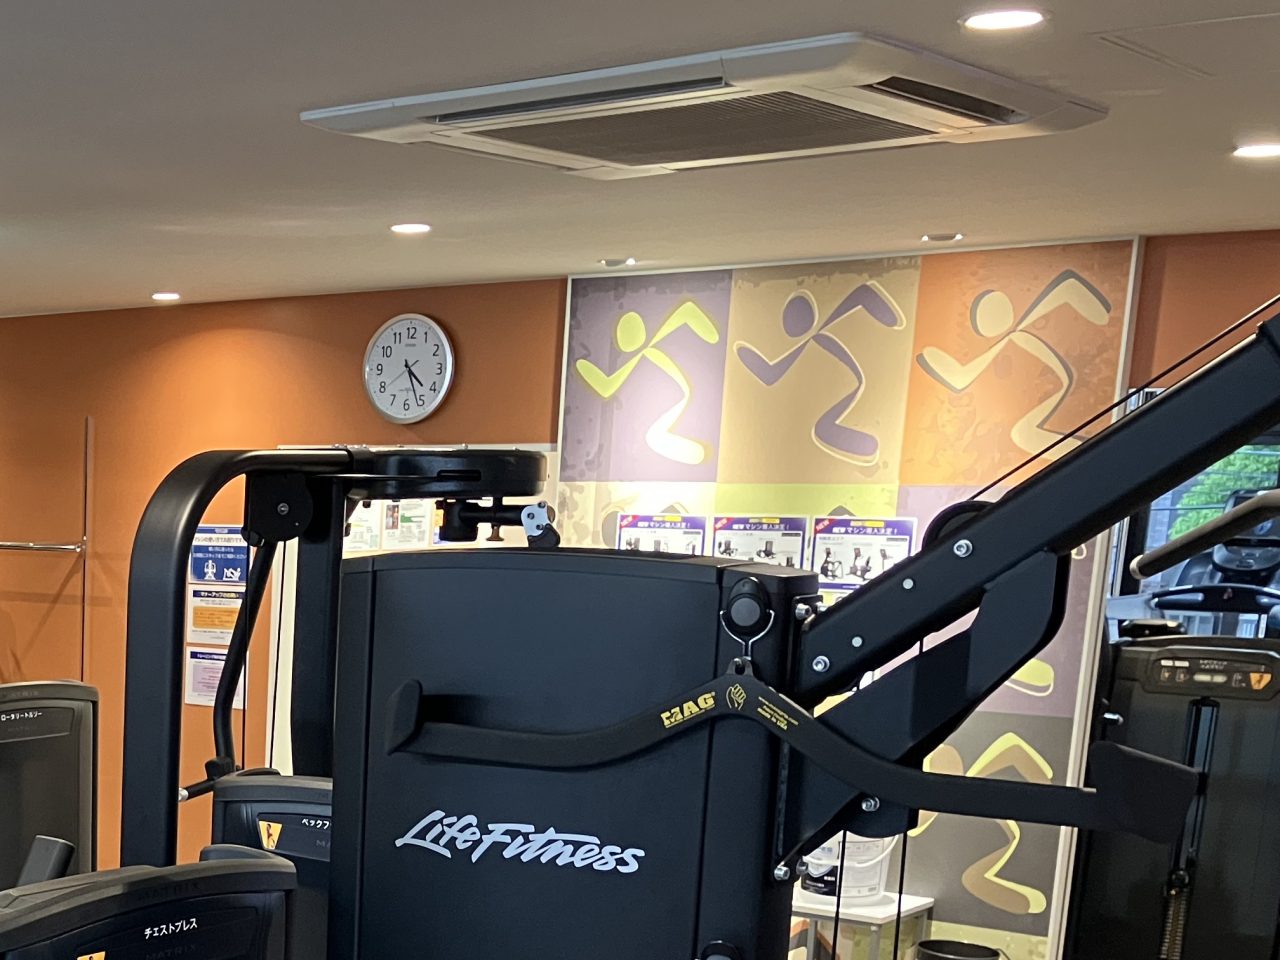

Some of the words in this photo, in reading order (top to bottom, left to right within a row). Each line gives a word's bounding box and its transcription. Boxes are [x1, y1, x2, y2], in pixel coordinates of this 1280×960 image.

[393, 332, 402, 344] 11
[406, 327, 417, 340] 12
[381, 345, 393, 358] 10
[432, 344, 440, 357] 2
[376, 363, 383, 376] 9
[436, 363, 443, 376] 3
[379, 381, 387, 394] 8
[429, 381, 437, 393] 4
[390, 394, 397, 406] 7
[403, 399, 410, 411] 6
[417, 394, 425, 407] 5
[660, 692, 716, 727] MAG
[301, 818, 331, 830] ペックフ
[143, 917, 199, 940] チェストプレス
